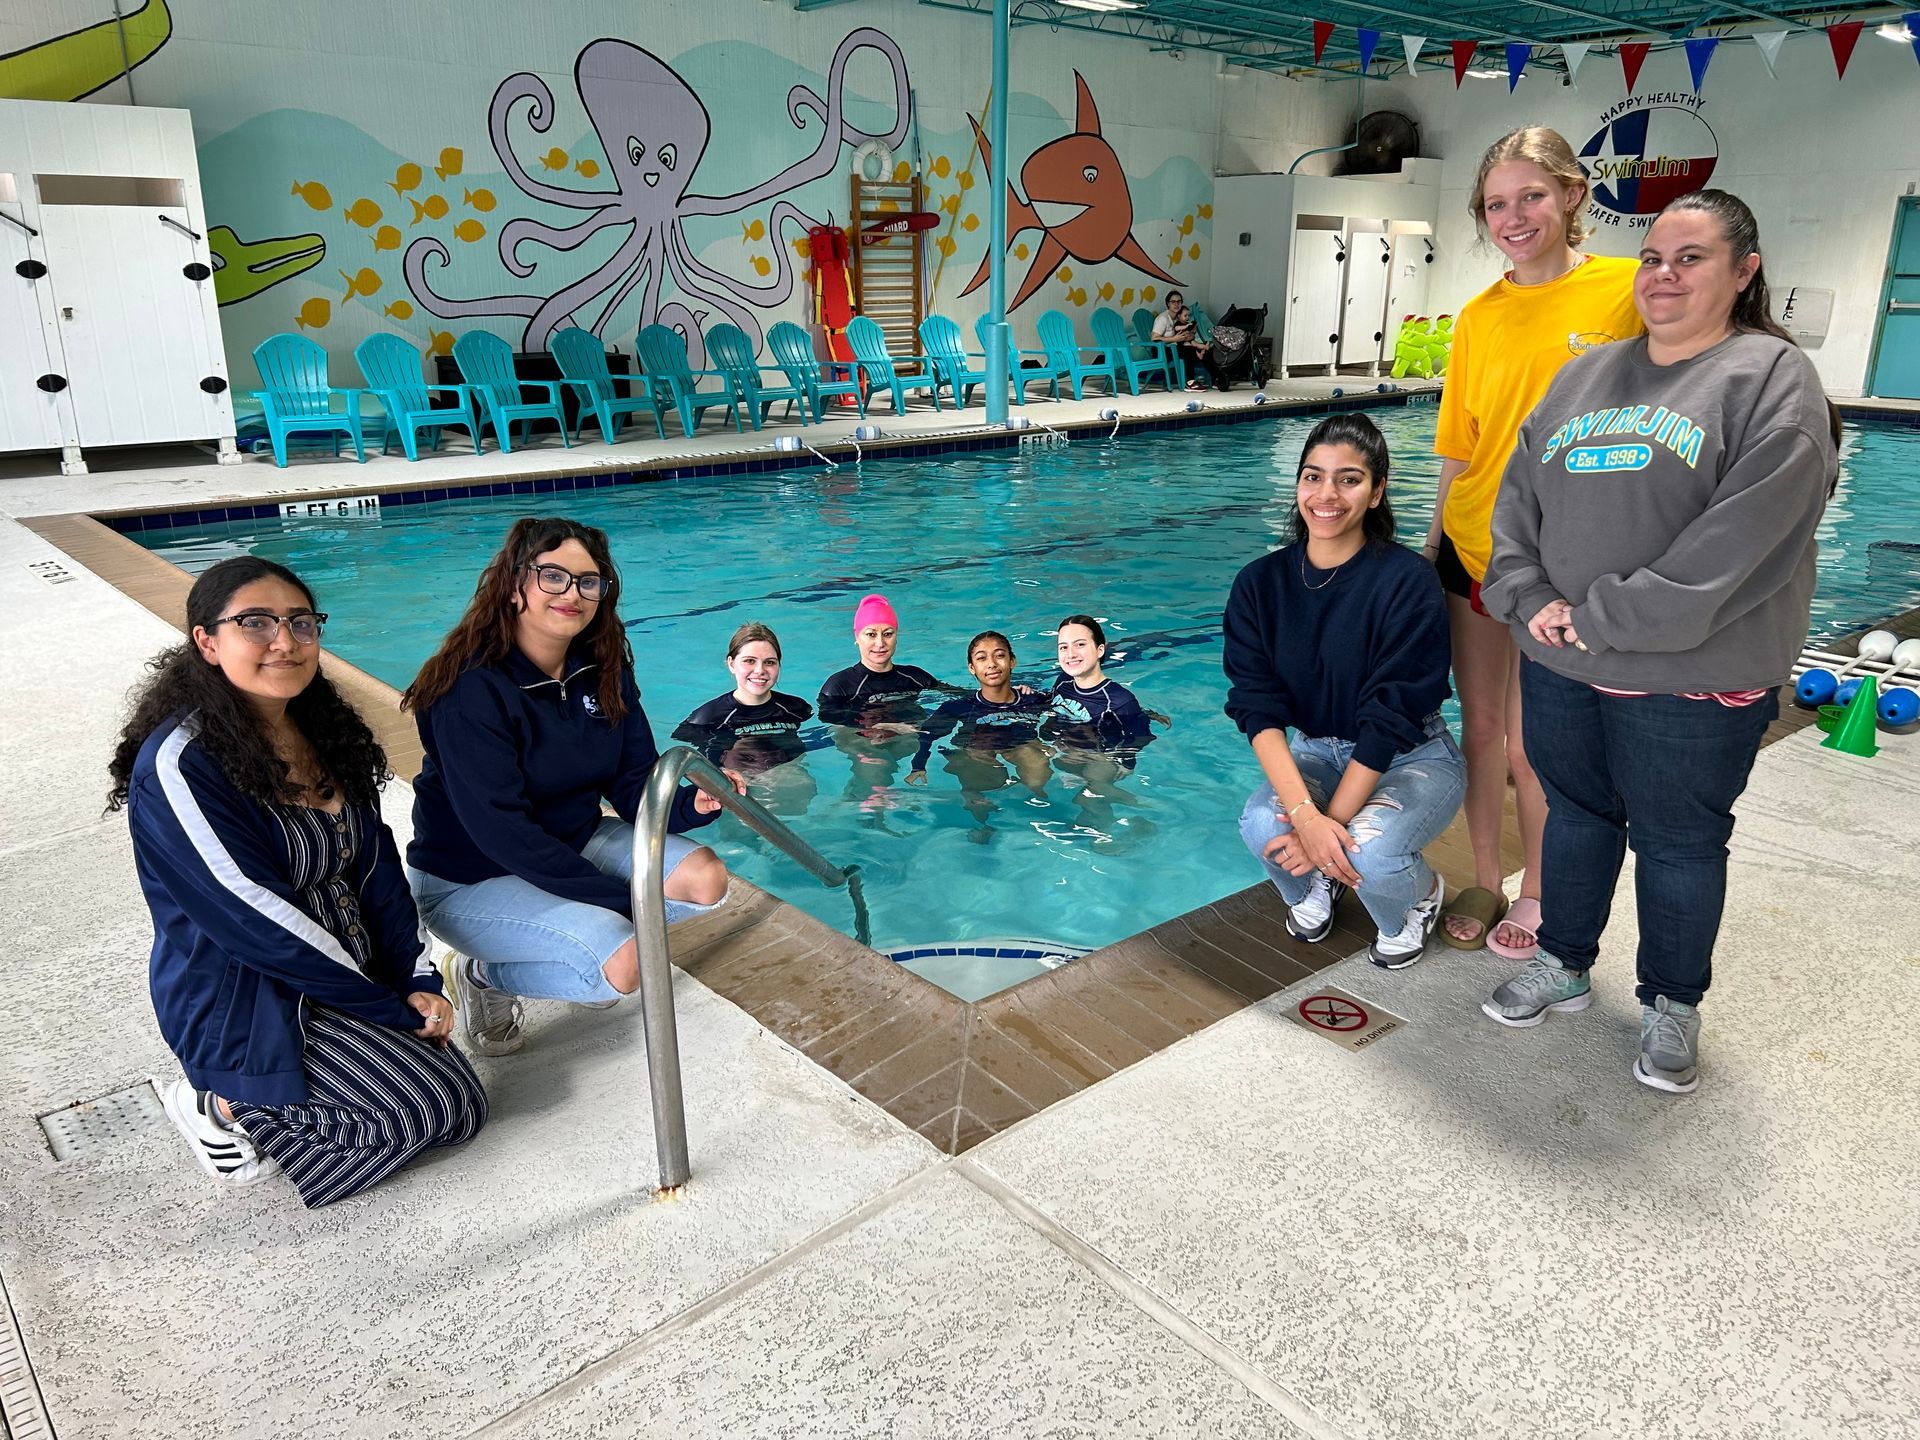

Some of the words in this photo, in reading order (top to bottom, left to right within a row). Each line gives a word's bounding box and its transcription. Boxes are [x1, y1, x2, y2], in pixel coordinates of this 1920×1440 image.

[1600, 96, 1643, 124] HAPPY
[1647, 92, 1706, 109] HEALTHY
[1591, 155, 1690, 180] SwimJim
[1587, 203, 1621, 227] SAFER
[1629, 216, 1656, 228] SWI
[1541, 404, 1706, 470] SWIMJIM
[1575, 452, 1599, 468] Est.
[1604, 450, 1638, 466] 1998
[1353, 1037, 1369, 1047] NO
[1367, 1021, 1396, 1039] DIVING
